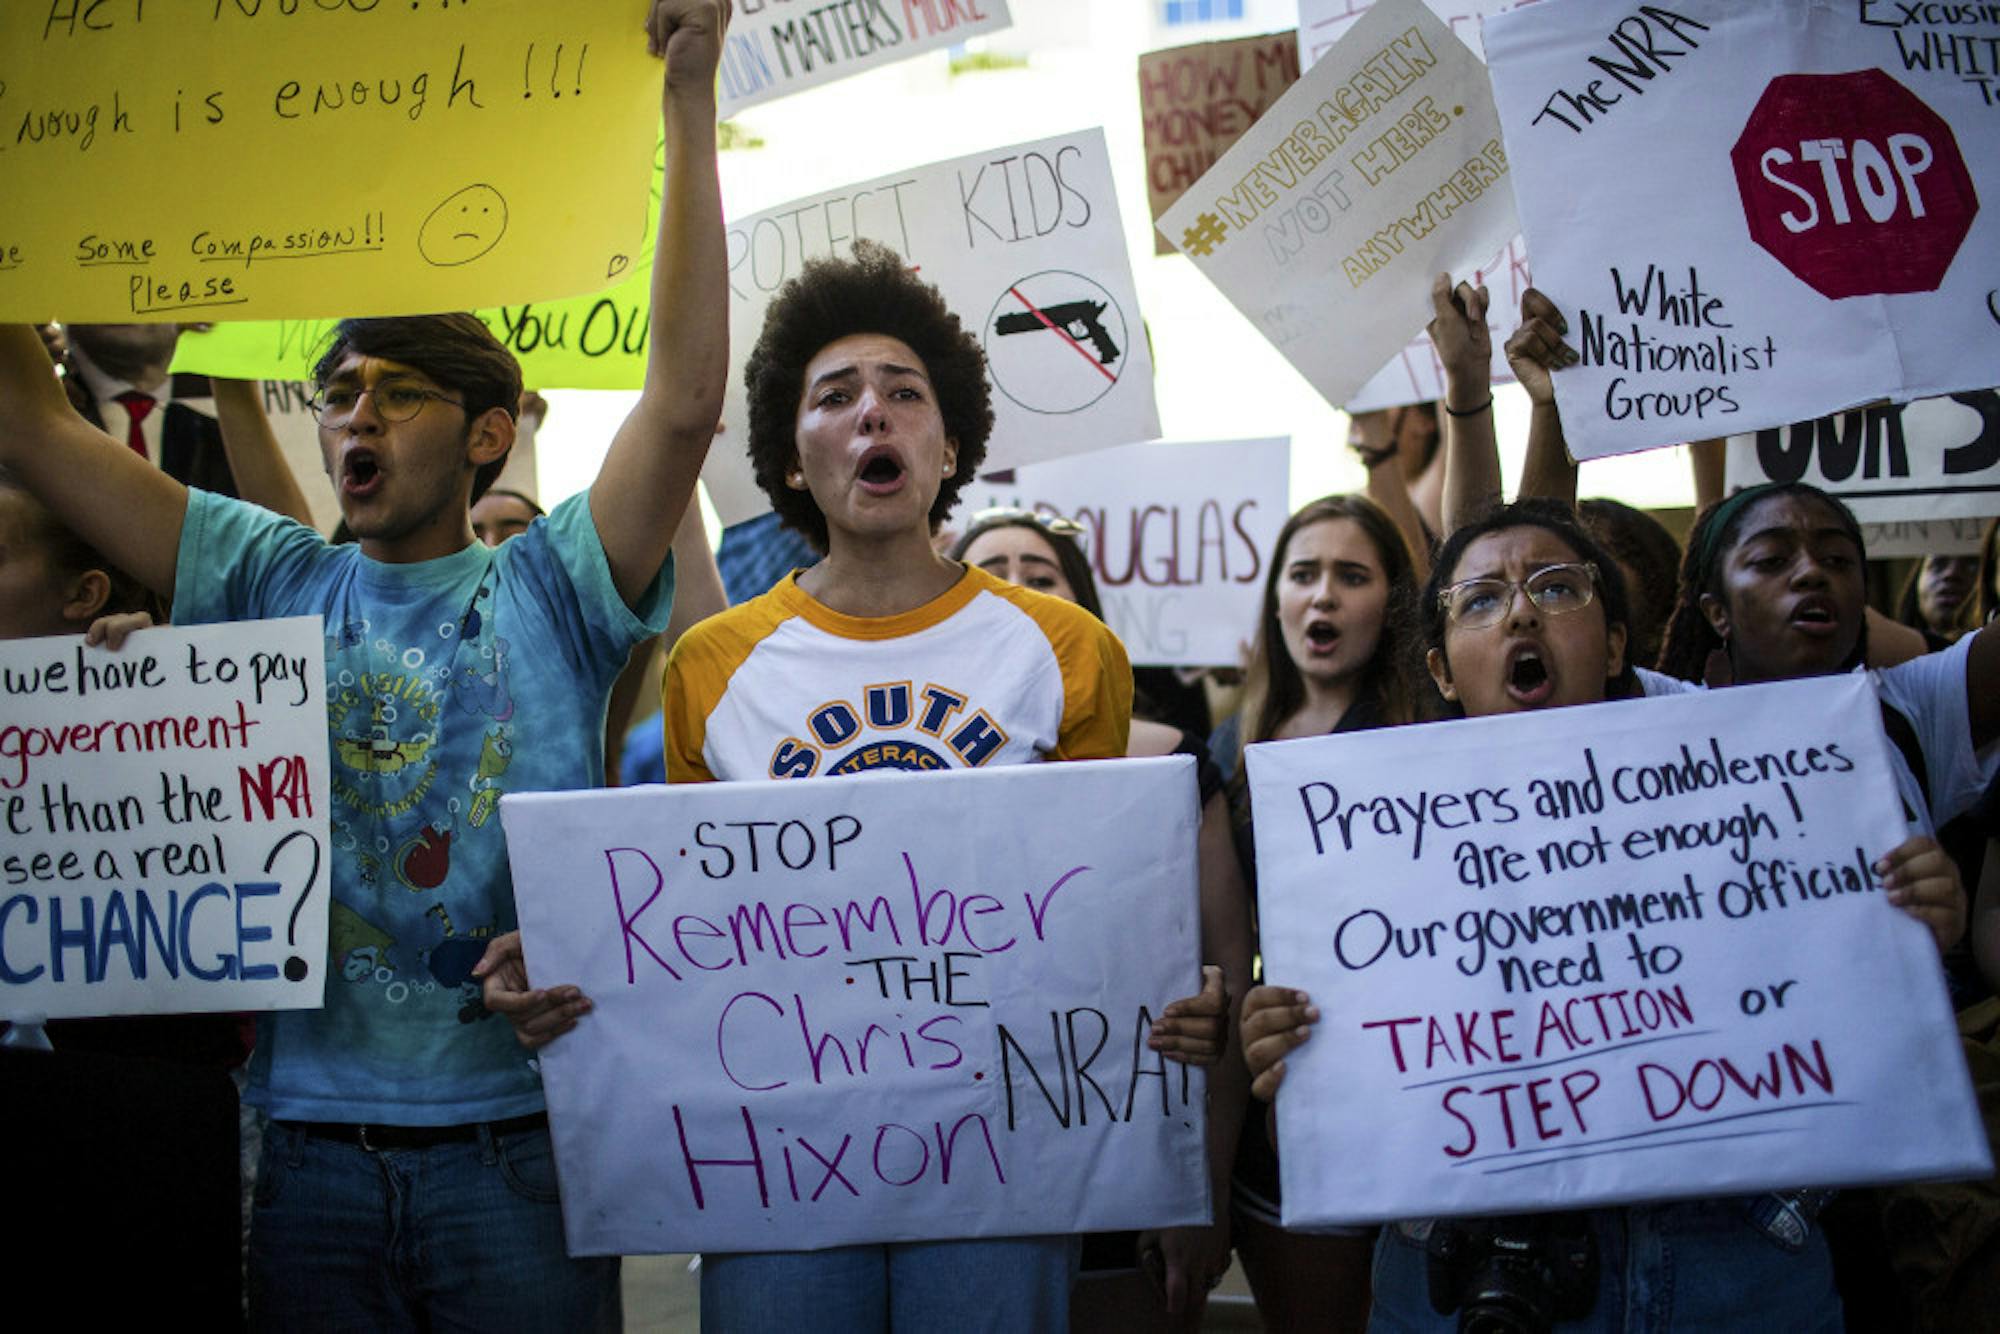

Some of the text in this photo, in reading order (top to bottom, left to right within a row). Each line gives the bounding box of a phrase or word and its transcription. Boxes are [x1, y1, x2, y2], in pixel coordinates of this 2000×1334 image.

[770, 0, 903, 80] MATTERS
[1142, 48, 1246, 108] HOW
[1532, 4, 1711, 134] The NRA
[175, 89, 225, 133] is
[1182, 26, 1437, 257] #NEVERAGAIN
[957, 145, 1091, 249] KIDS
[1263, 168, 1354, 267] NOT
[1340, 138, 1510, 289] ANYWHERE
[1760, 133, 1934, 235] STOP
[75, 234, 157, 262] Some
[129, 273, 236, 313] Please
[1610, 264, 1734, 330] White
[1579, 308, 1778, 378] Nationalist
[1604, 376, 1740, 422] Groups
[4, 661, 69, 695] we
[76, 645, 166, 696] have
[186, 643, 240, 686] to
[249, 650, 309, 707] pay
[0, 699, 261, 790] government
[768, 679, 1010, 780] SOUTH
[42, 783, 146, 833] than
[161, 771, 233, 824] the
[238, 755, 314, 823] NRA
[1299, 737, 1856, 860] Prayers and condolences
[3, 849, 86, 884] see
[133, 834, 228, 880] real
[694, 814, 863, 879] STOP
[1453, 839, 1532, 890] are
[1538, 825, 1614, 871] not
[604, 846, 1094, 985] Remember
[1333, 908, 1449, 972] Our
[1455, 875, 1706, 978] government
[844, 951, 990, 1009] THE
[1498, 933, 1683, 994] need to
[717, 991, 965, 1092] Chris
[1361, 978, 1798, 1075] TAKE ACTION or
[1442, 1038, 1835, 1161] STEP DOWN
[672, 1104, 1006, 1211] Hixon
